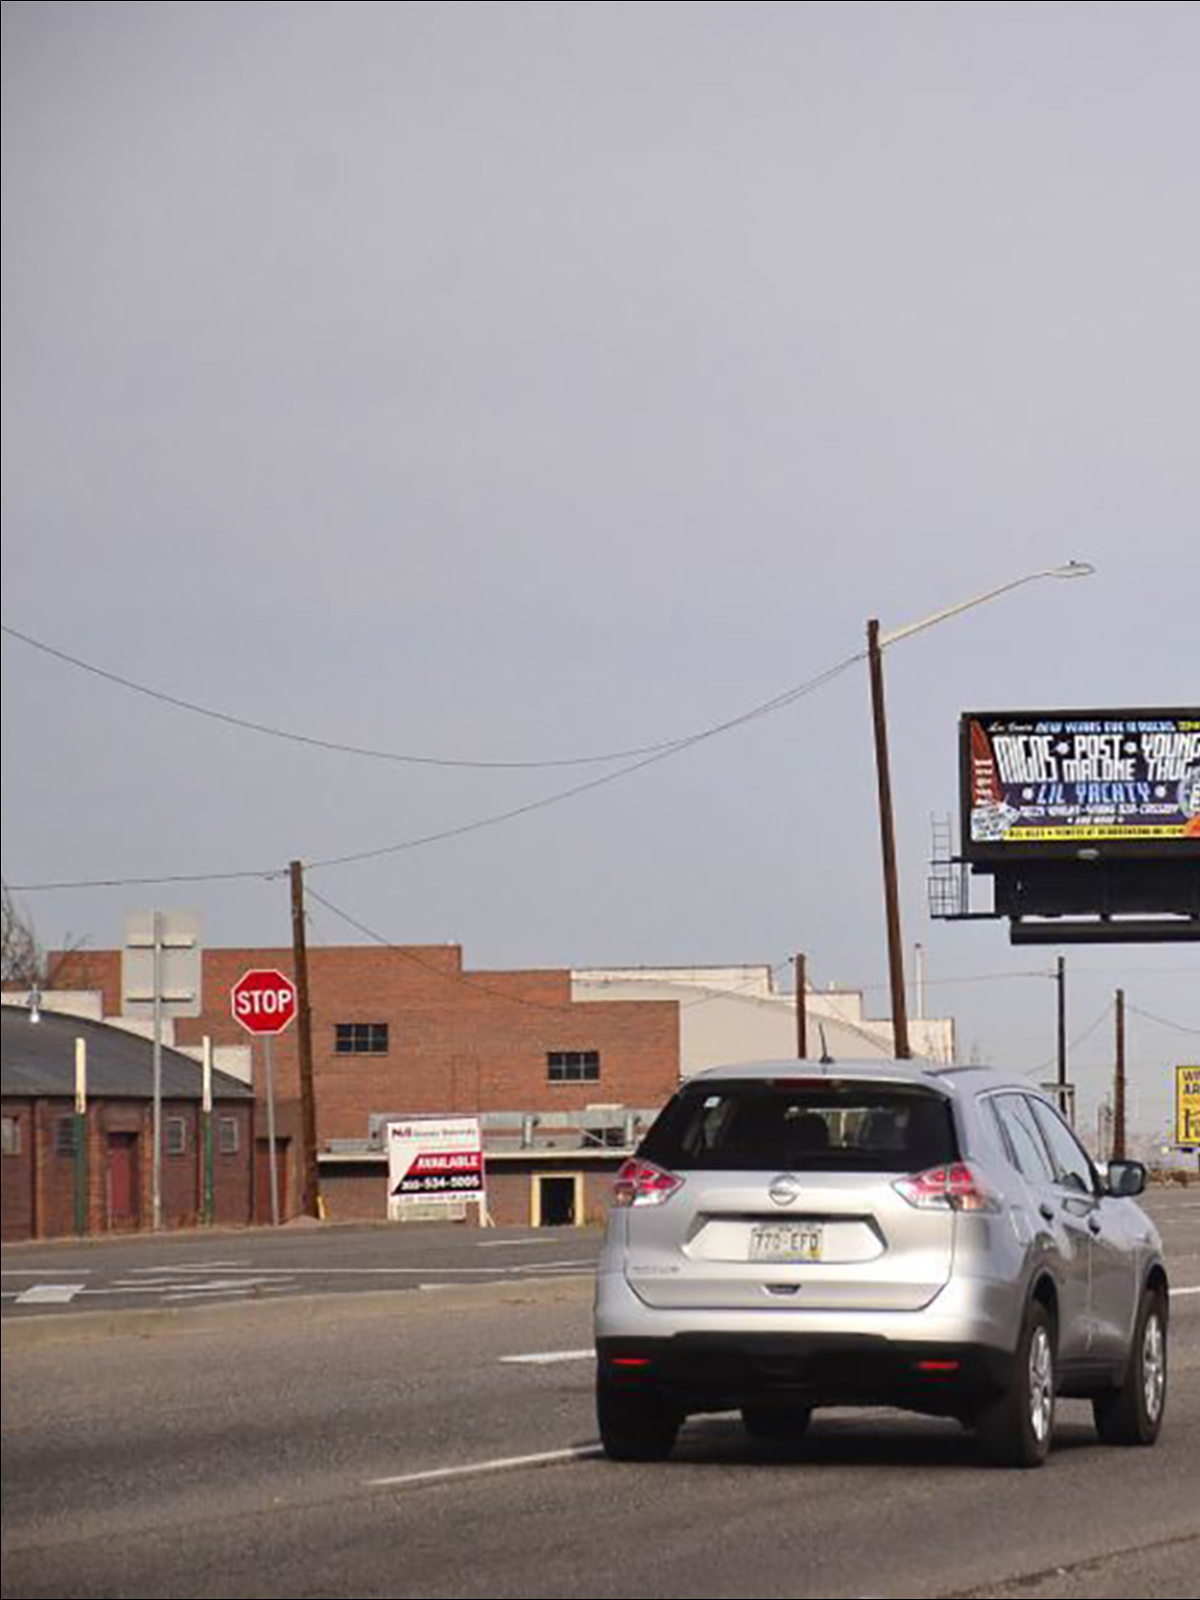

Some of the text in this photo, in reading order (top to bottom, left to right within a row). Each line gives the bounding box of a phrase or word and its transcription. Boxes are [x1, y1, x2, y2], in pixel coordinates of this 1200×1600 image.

[992, 735, 1058, 783] MIGOS
[1074, 735, 1124, 760] POST
[1062, 758, 1136, 782] MALONE
[1037, 782, 1150, 804] LIL YACHTY
[237, 989, 292, 1015] STOP
[418, 1155, 479, 1169] AVAILABLE
